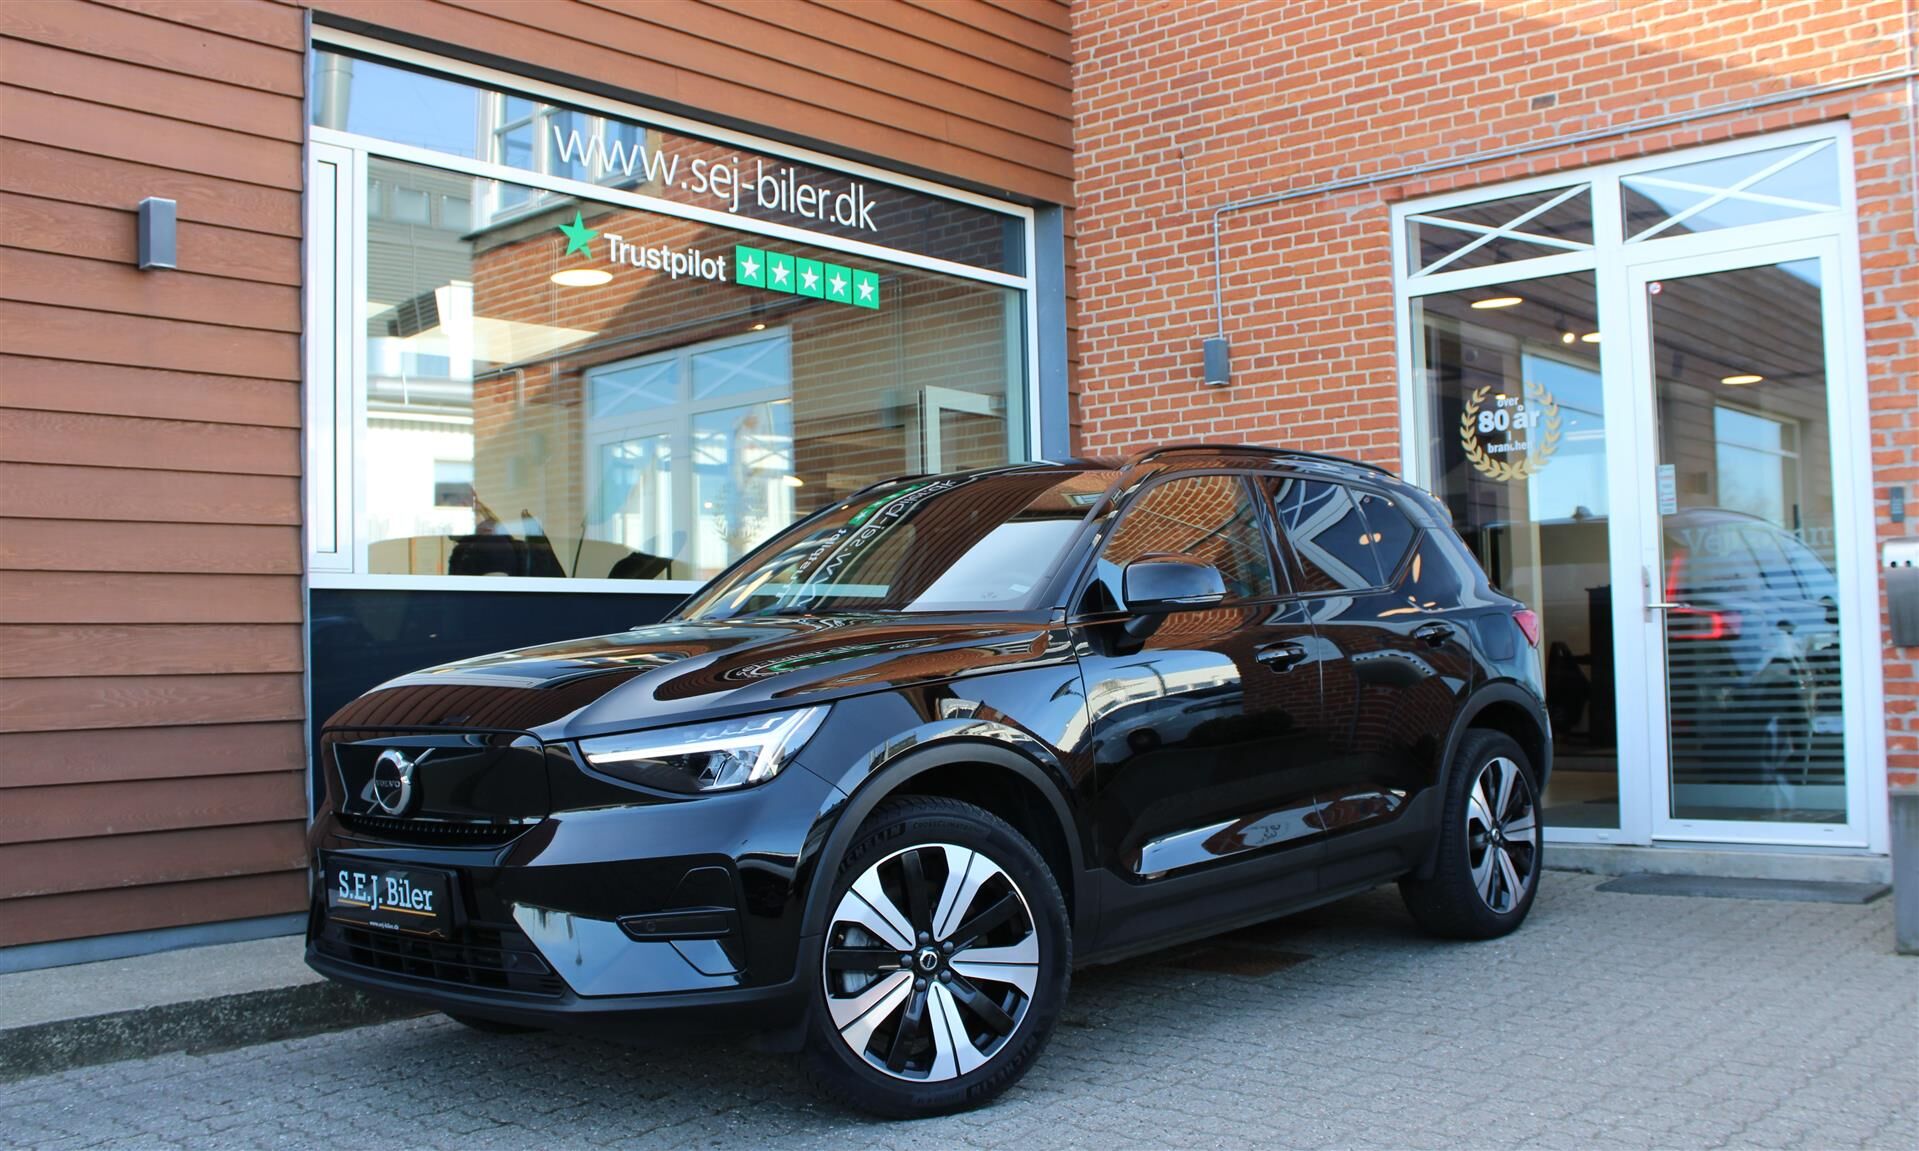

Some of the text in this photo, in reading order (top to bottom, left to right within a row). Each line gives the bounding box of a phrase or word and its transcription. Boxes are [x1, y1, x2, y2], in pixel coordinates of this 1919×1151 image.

[553, 125, 877, 232] www.sej-biler.dk
[603, 232, 727, 283] Trustpilot
[1478, 404, 1539, 432] 80 år
[1497, 396, 1519, 407] over
[338, 870, 432, 911] S.E.J. Biler
